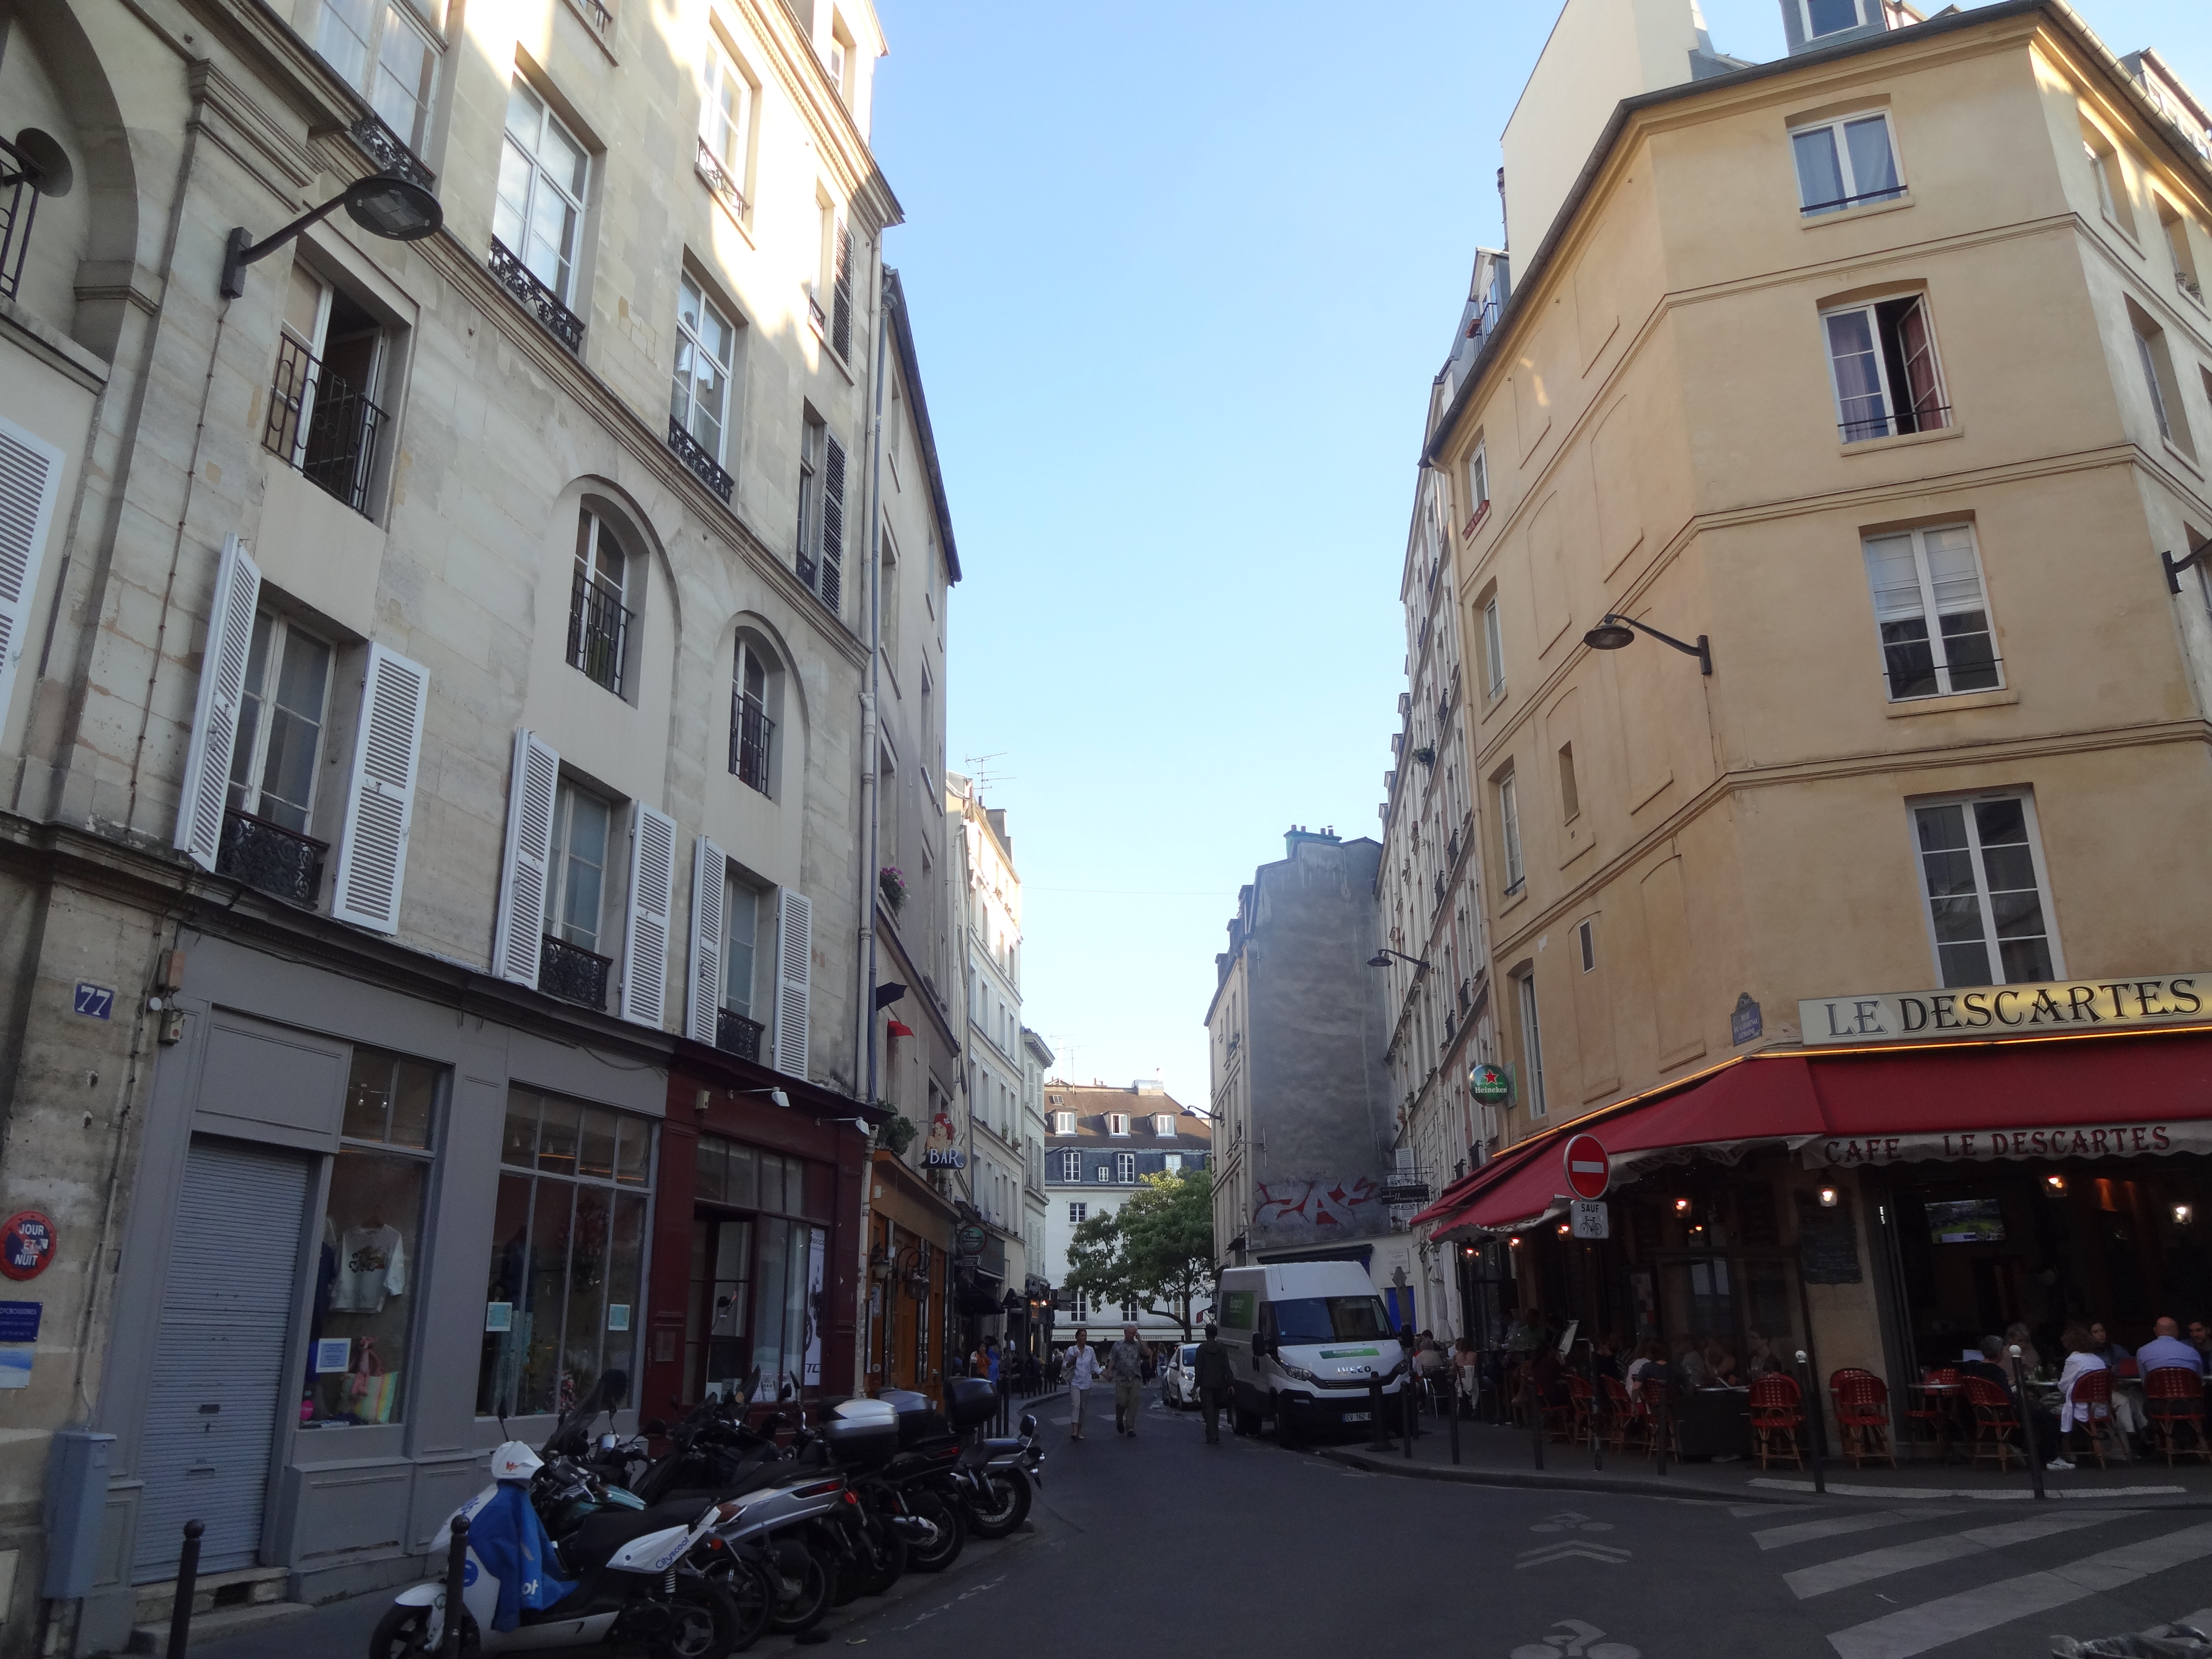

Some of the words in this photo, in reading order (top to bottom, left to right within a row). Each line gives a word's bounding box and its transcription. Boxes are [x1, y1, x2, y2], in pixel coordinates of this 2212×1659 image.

[78, 985, 110, 1016] 77
[1824, 1000, 1888, 1037] LE
[1898, 979, 2202, 1034] DESCARTES
[1824, 1138, 1903, 1164] CAFE
[1944, 1134, 1978, 1157] LE
[1991, 1125, 2171, 1157] DESCARTES
[929, 1148, 963, 1168] BAR
[1581, 1203, 1600, 1214] SAUF
[19, 1224, 44, 1236] JOUR
[14, 1254, 38, 1266] NUIT
[1337, 1365, 1371, 1374] IVECO
[655, 1536, 689, 1569] Cityscoot
